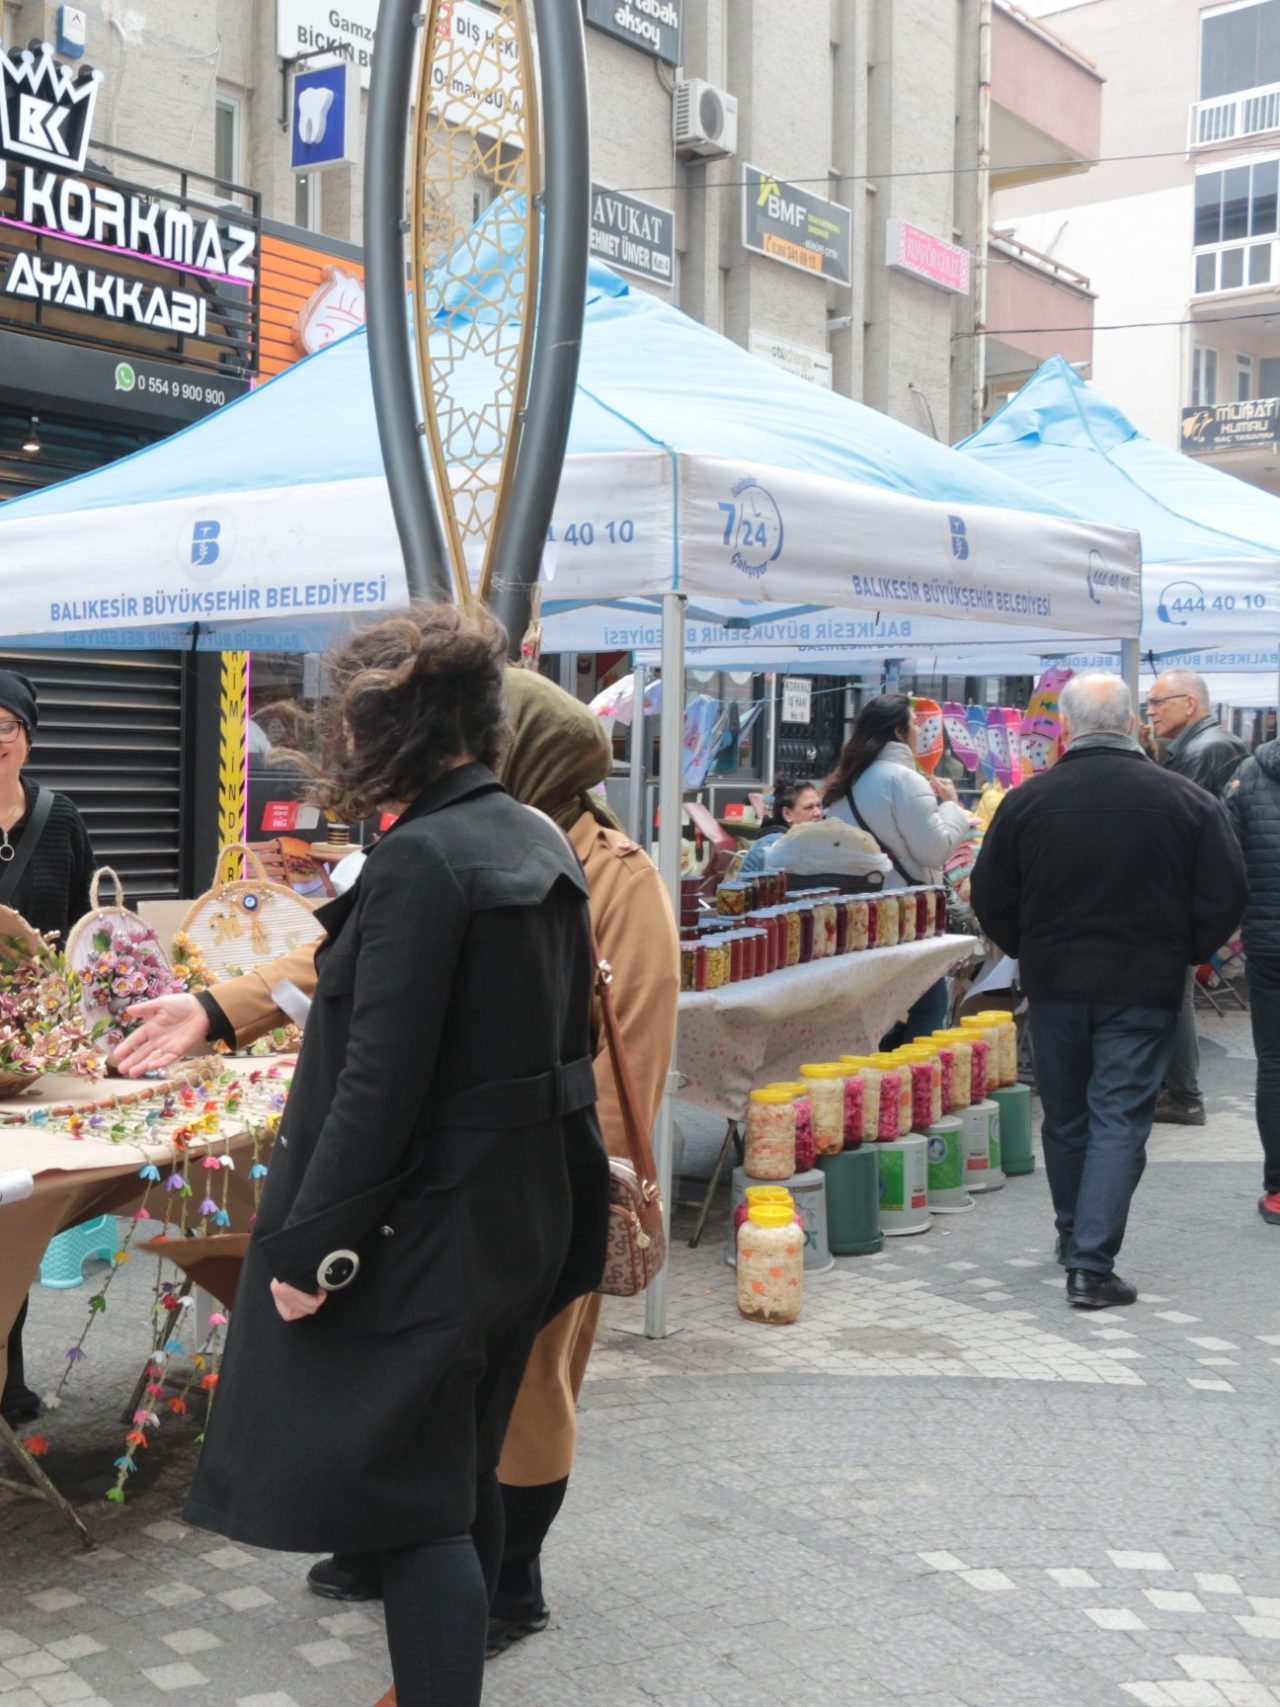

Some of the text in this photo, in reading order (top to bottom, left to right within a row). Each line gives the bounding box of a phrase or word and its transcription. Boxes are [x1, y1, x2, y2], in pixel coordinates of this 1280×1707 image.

[456, 17, 481, 46] DİŞ
[614, 4, 661, 50] aksoy
[18, 92, 71, 157] BK
[22, 165, 257, 282] KORKMAZ
[593, 194, 663, 245] AVUKAT
[767, 194, 808, 228] BMF
[5, 251, 207, 338] AYAKKABI
[137, 374, 226, 406] 0 554 9 900 900
[1215, 402, 1275, 422] MURAT
[563, 521, 595, 546] 40
[605, 519, 635, 544] 10
[50, 574, 387, 622] BALIKESİR BÜYÜKŞEHİR BELEDİYESİ
[852, 574, 1052, 617] BALIKESİR BÜYÜKŞEHİR BELEDİYESİ
[1171, 593, 1266, 613] 444 40 10
